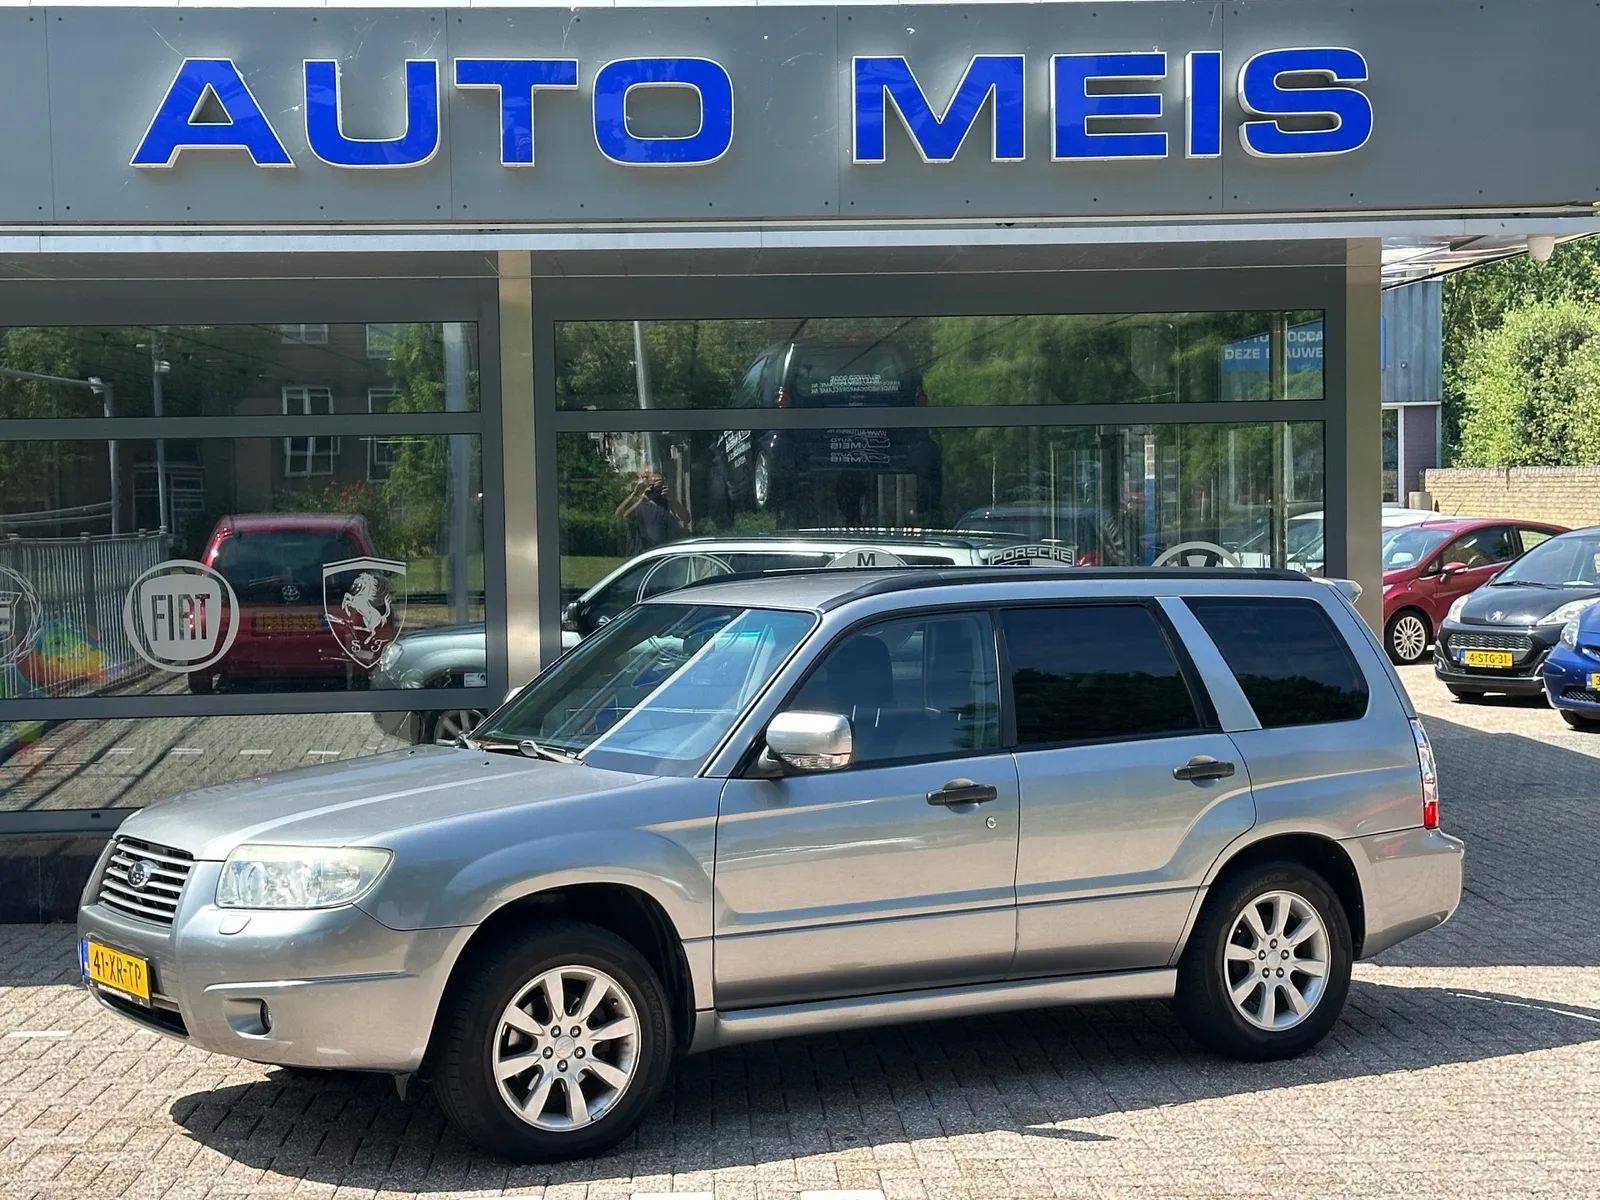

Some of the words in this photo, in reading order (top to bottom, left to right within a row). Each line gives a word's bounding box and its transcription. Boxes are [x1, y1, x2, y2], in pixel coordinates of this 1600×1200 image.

[129, 56, 735, 169] AUTO
[852, 46, 1373, 164] MEIS
[1224, 348, 1260, 360] DEZE
[857, 552, 876, 567] M
[991, 547, 1072, 565] PORSCHE
[151, 593, 211, 642] FIAT
[351, 639, 361, 653] S
[1469, 653, 1508, 664] 4-STG-31
[93, 949, 142, 991] 41-XR-TP
